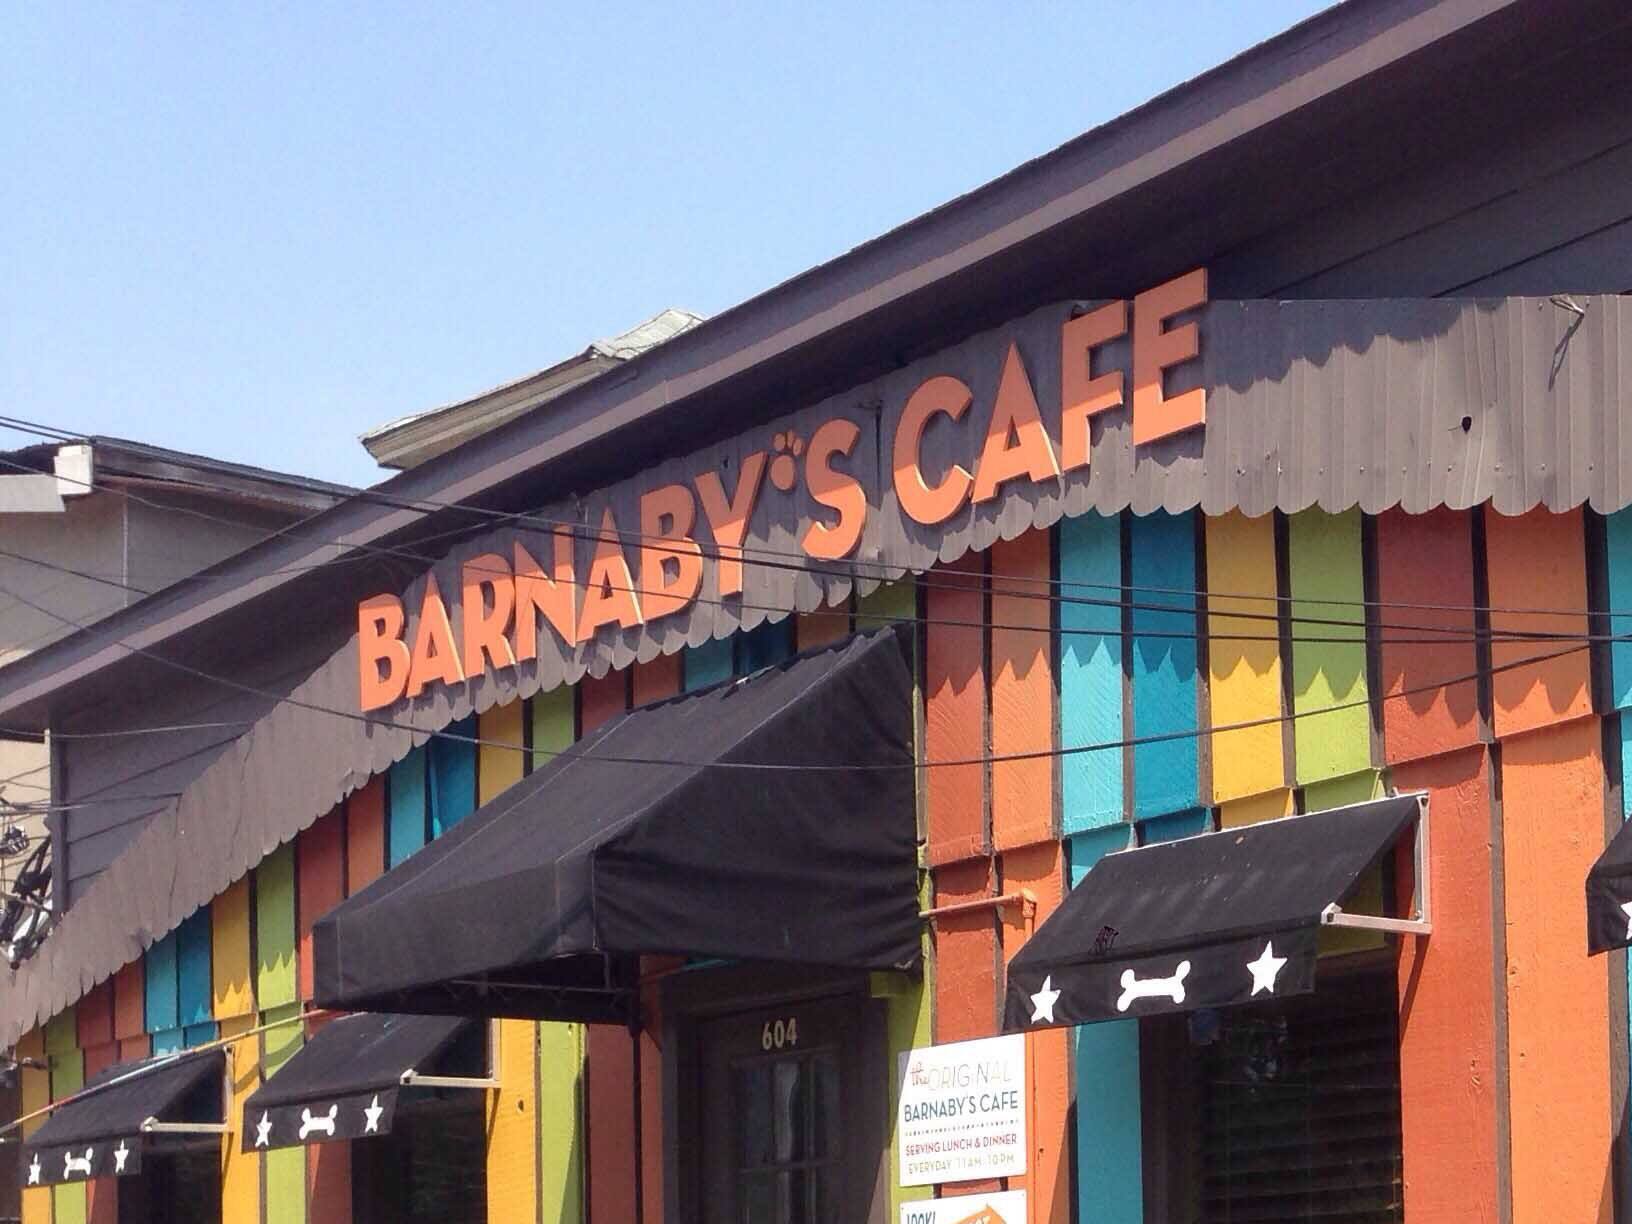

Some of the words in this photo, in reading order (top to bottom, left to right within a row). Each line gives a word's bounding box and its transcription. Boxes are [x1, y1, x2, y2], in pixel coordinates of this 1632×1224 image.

[359, 418, 867, 713] BARNABY'S
[893, 267, 1209, 525] CAFE
[762, 1017, 798, 1050] 604
[910, 1060, 929, 1087] the
[904, 1095, 976, 1122] BARNABY'S
[980, 1090, 1018, 1113] CAFE
[905, 1142, 941, 1157] SERVING
[942, 1138, 973, 1152] LUNCH
[974, 1137, 981, 1149] &
[983, 1133, 1017, 1148] DINNER
[908, 1159, 952, 1175] EVERYDAY
